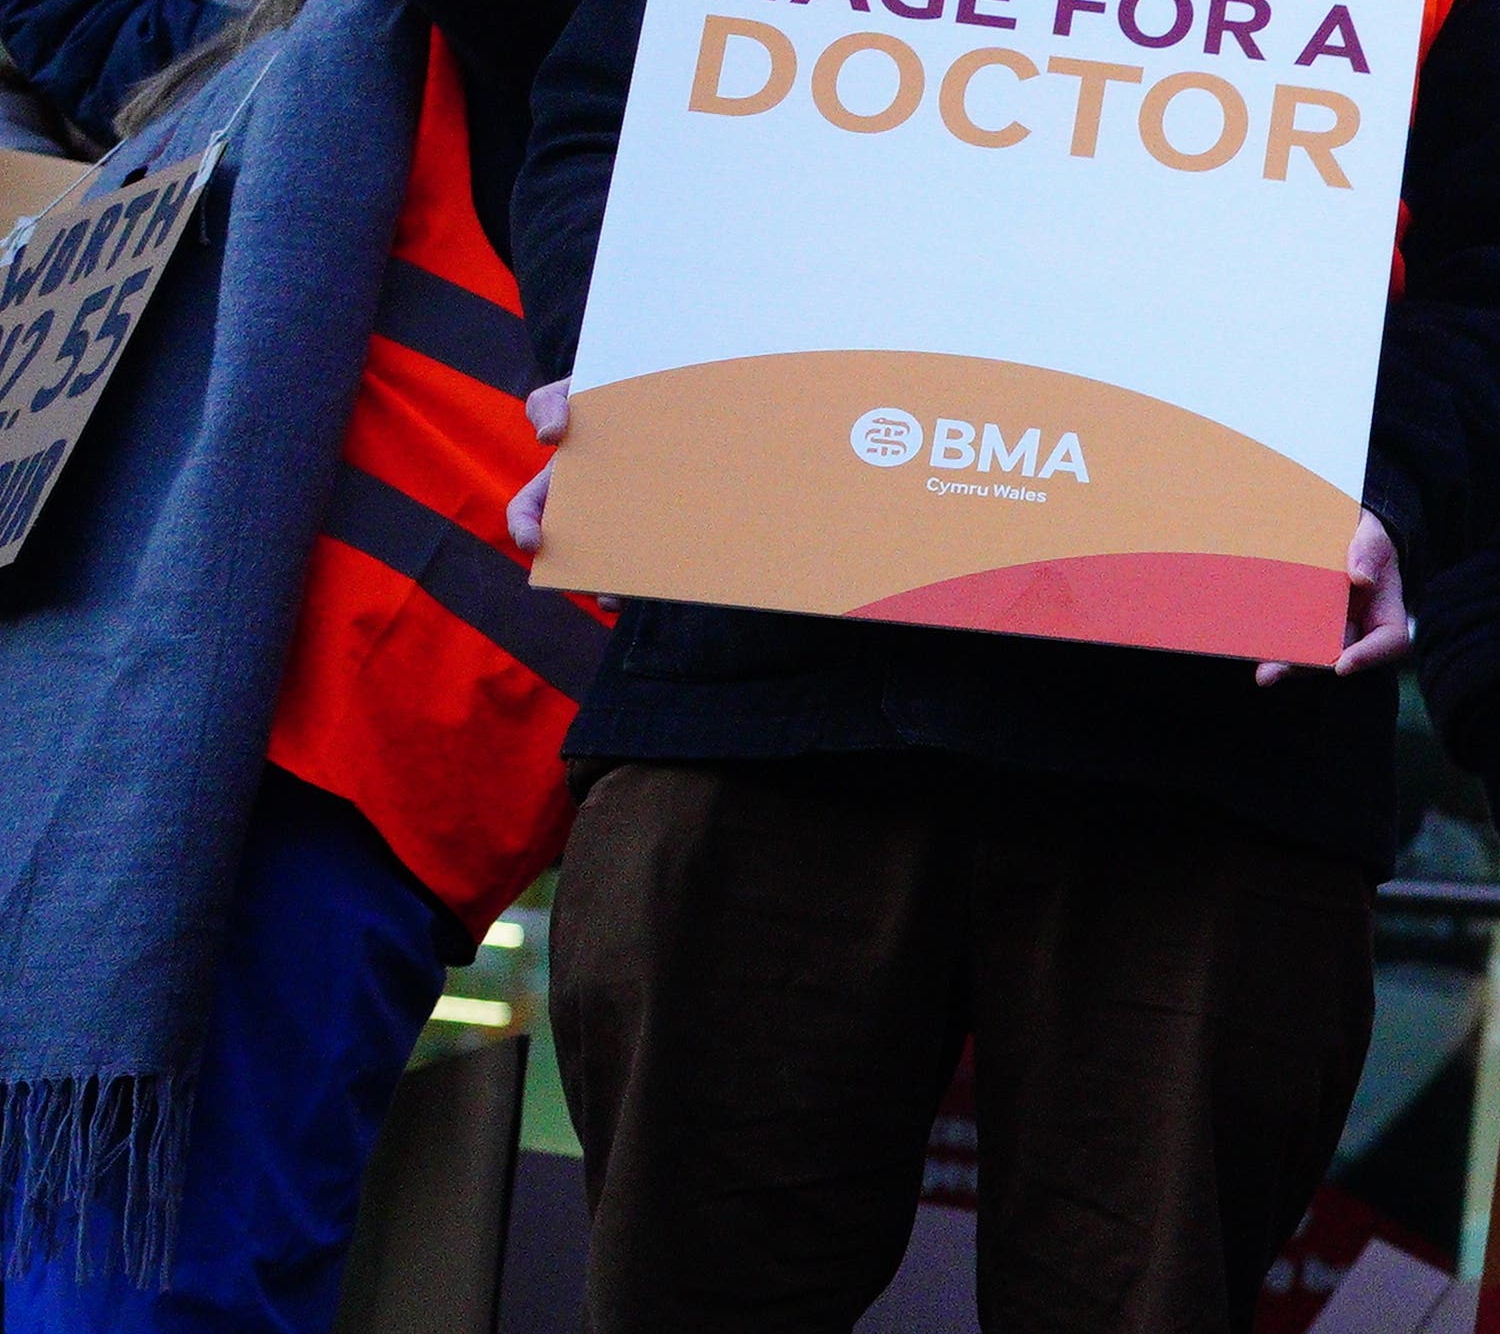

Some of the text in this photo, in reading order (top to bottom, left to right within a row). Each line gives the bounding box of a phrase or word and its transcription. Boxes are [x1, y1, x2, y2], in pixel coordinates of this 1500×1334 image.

[1293, 3, 1372, 75] A
[686, 14, 1362, 191] DOCTOR
[928, 416, 1091, 486] BMA
[926, 477, 1048, 505] Cymru Wales
